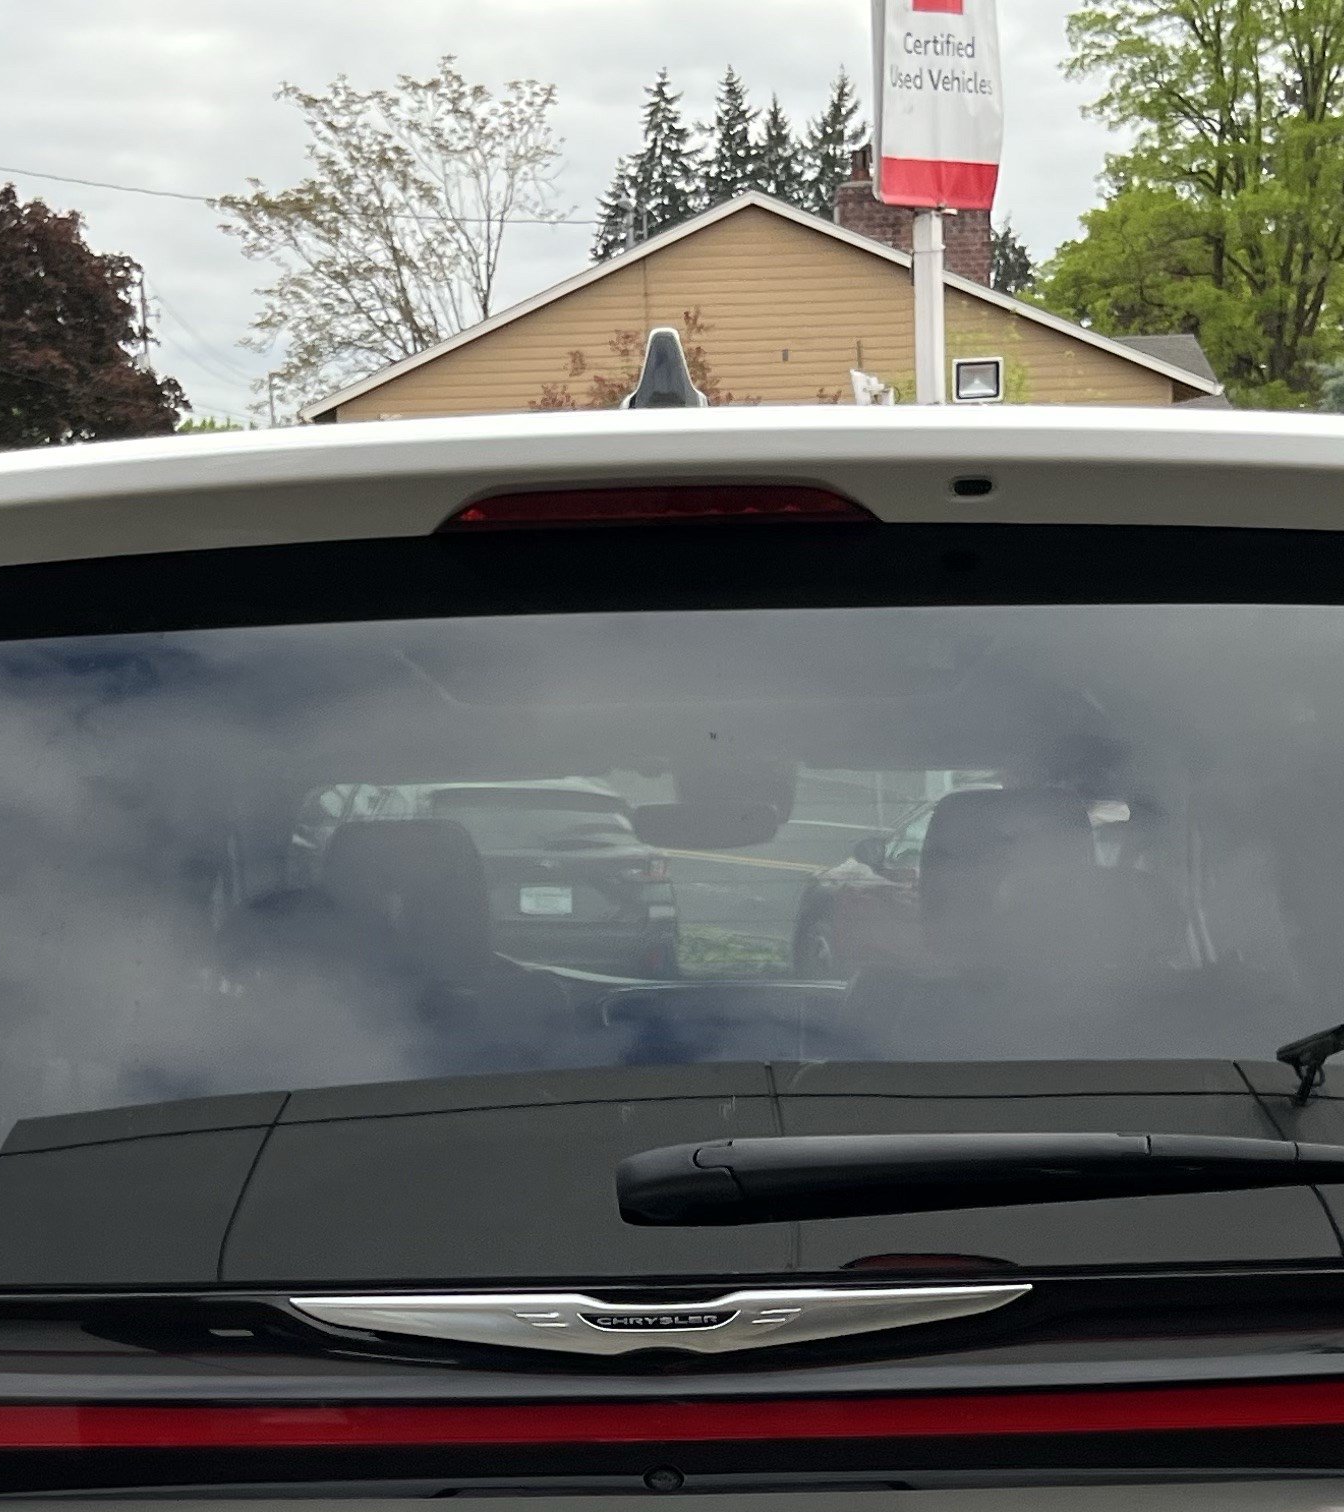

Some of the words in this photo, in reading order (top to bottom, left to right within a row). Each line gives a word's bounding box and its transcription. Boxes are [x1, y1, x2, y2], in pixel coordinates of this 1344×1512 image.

[903, 32, 976, 58] Certified
[890, 64, 923, 90] Used
[928, 68, 993, 96] Vehicles
[596, 1315, 718, 1326] CHRYSLER
